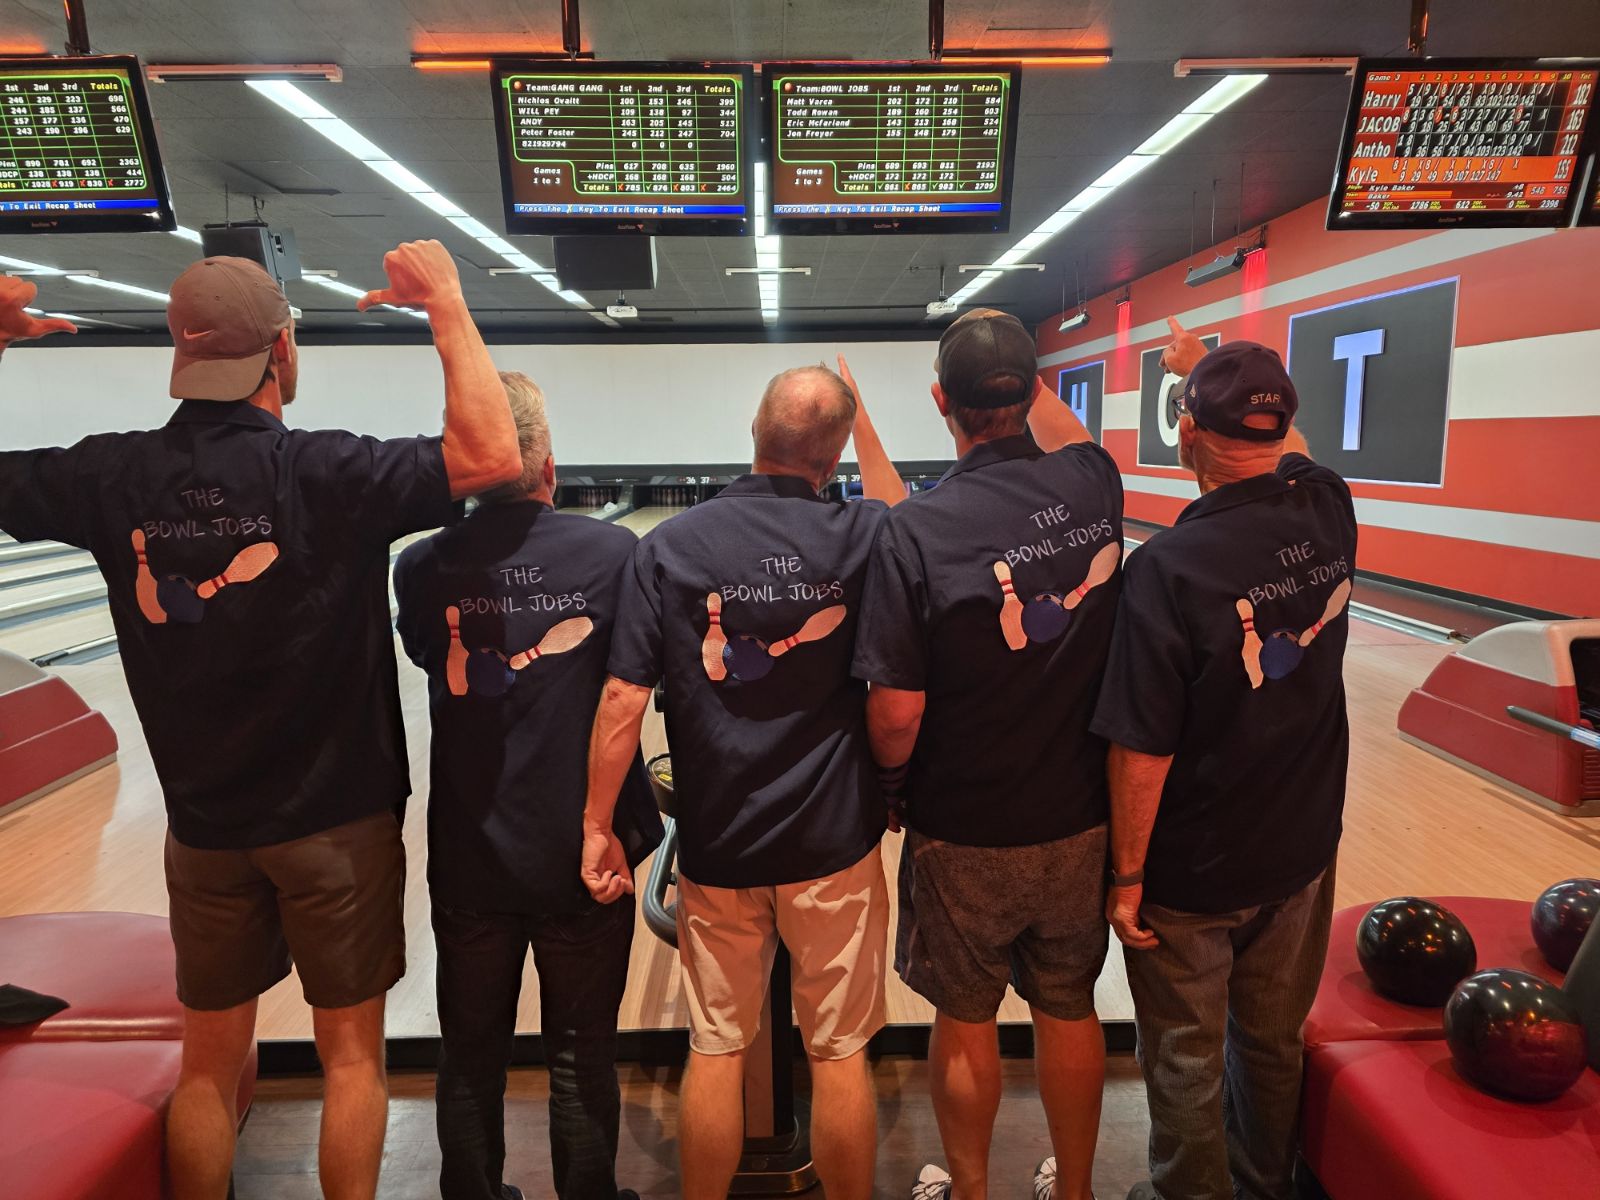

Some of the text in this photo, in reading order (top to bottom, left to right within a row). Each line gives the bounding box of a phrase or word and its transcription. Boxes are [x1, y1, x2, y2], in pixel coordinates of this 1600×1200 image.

[1363, 91, 1401, 110] Harry
[1359, 117, 1400, 132] JACOB
[1354, 141, 1390, 157] Antho
[1349, 167, 1378, 185] Kyle
[1410, 201, 1429, 209] 1786
[1250, 392, 1280, 404] STAR
[1333, 328, 1386, 451] T
[181, 488, 224, 508] THE
[1029, 504, 1070, 529] THE
[143, 515, 272, 539] BOWL JOBS
[1004, 519, 1112, 567] BOWL JOBS
[1275, 541, 1314, 567] THE
[761, 556, 801, 575] THE
[500, 567, 542, 585] THE
[1248, 556, 1348, 606] BOWL JOBS
[721, 581, 843, 602] BOWL JOBS
[460, 592, 586, 614] BOWL JOBS
